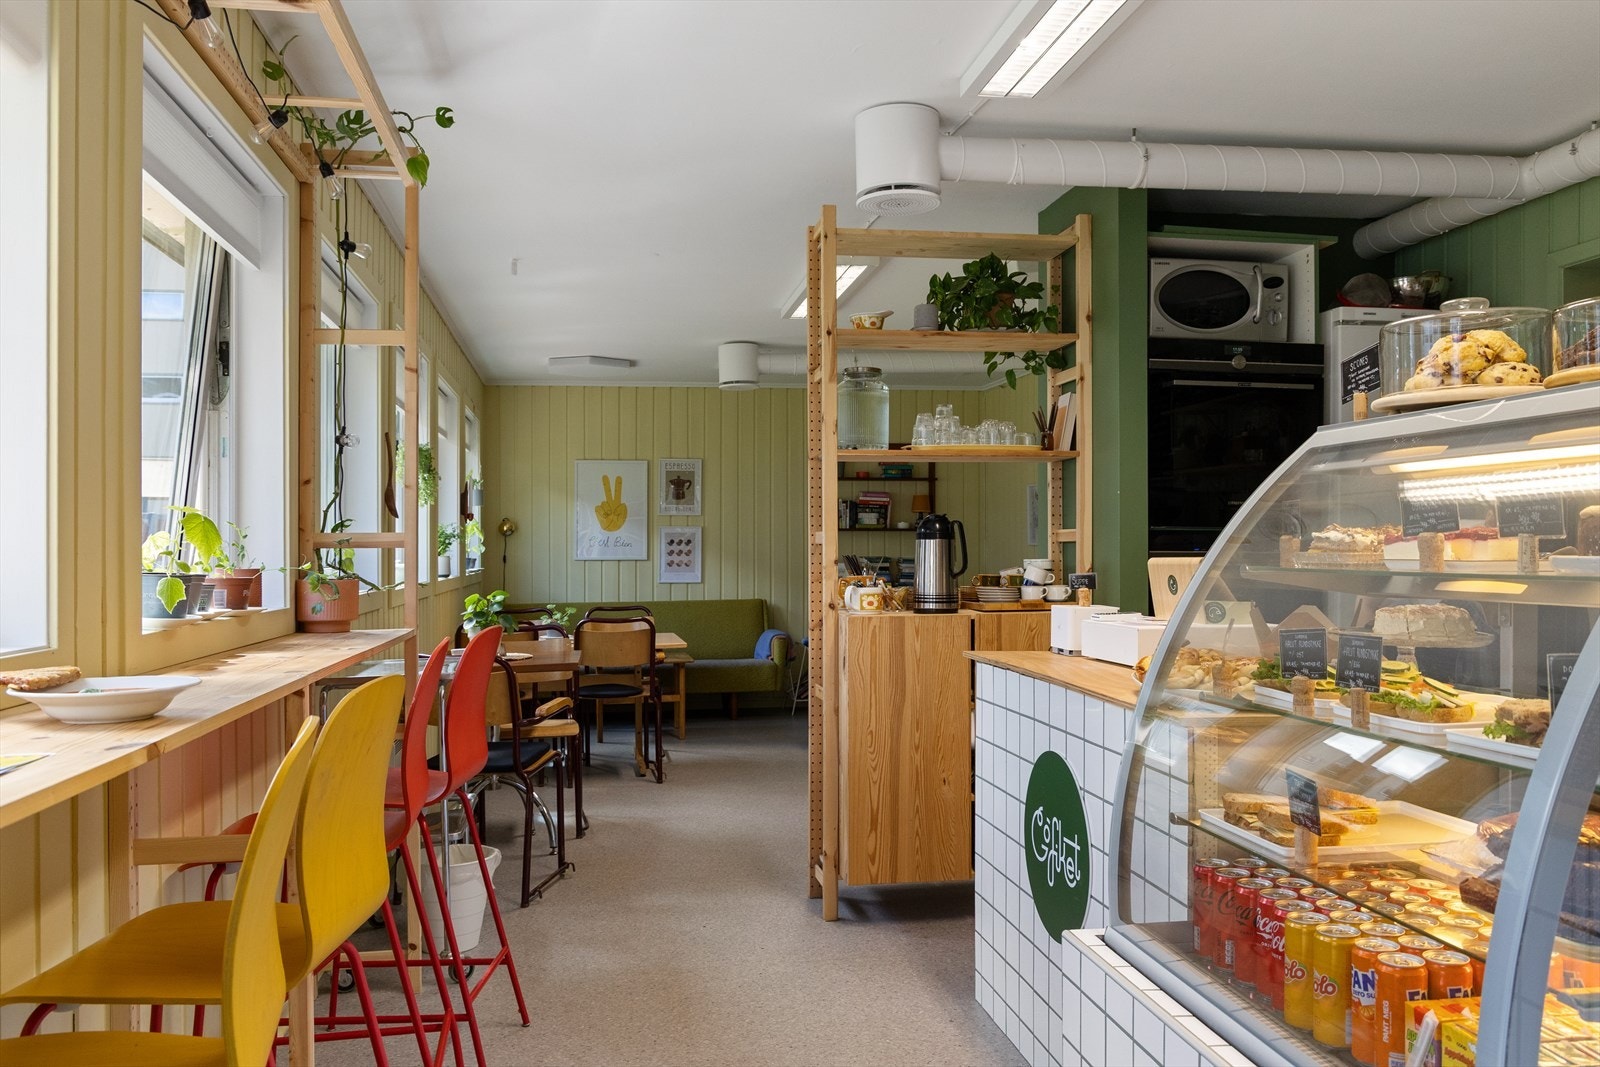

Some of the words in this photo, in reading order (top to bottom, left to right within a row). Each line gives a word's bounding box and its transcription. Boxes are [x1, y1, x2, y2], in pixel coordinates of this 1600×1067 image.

[664, 462, 695, 470] ESPRESSO
[1562, 665, 1573, 673] DO
[1284, 960, 1306, 980] olo
[1313, 975, 1337, 996] olo
[1408, 990, 1428, 1001] FA
